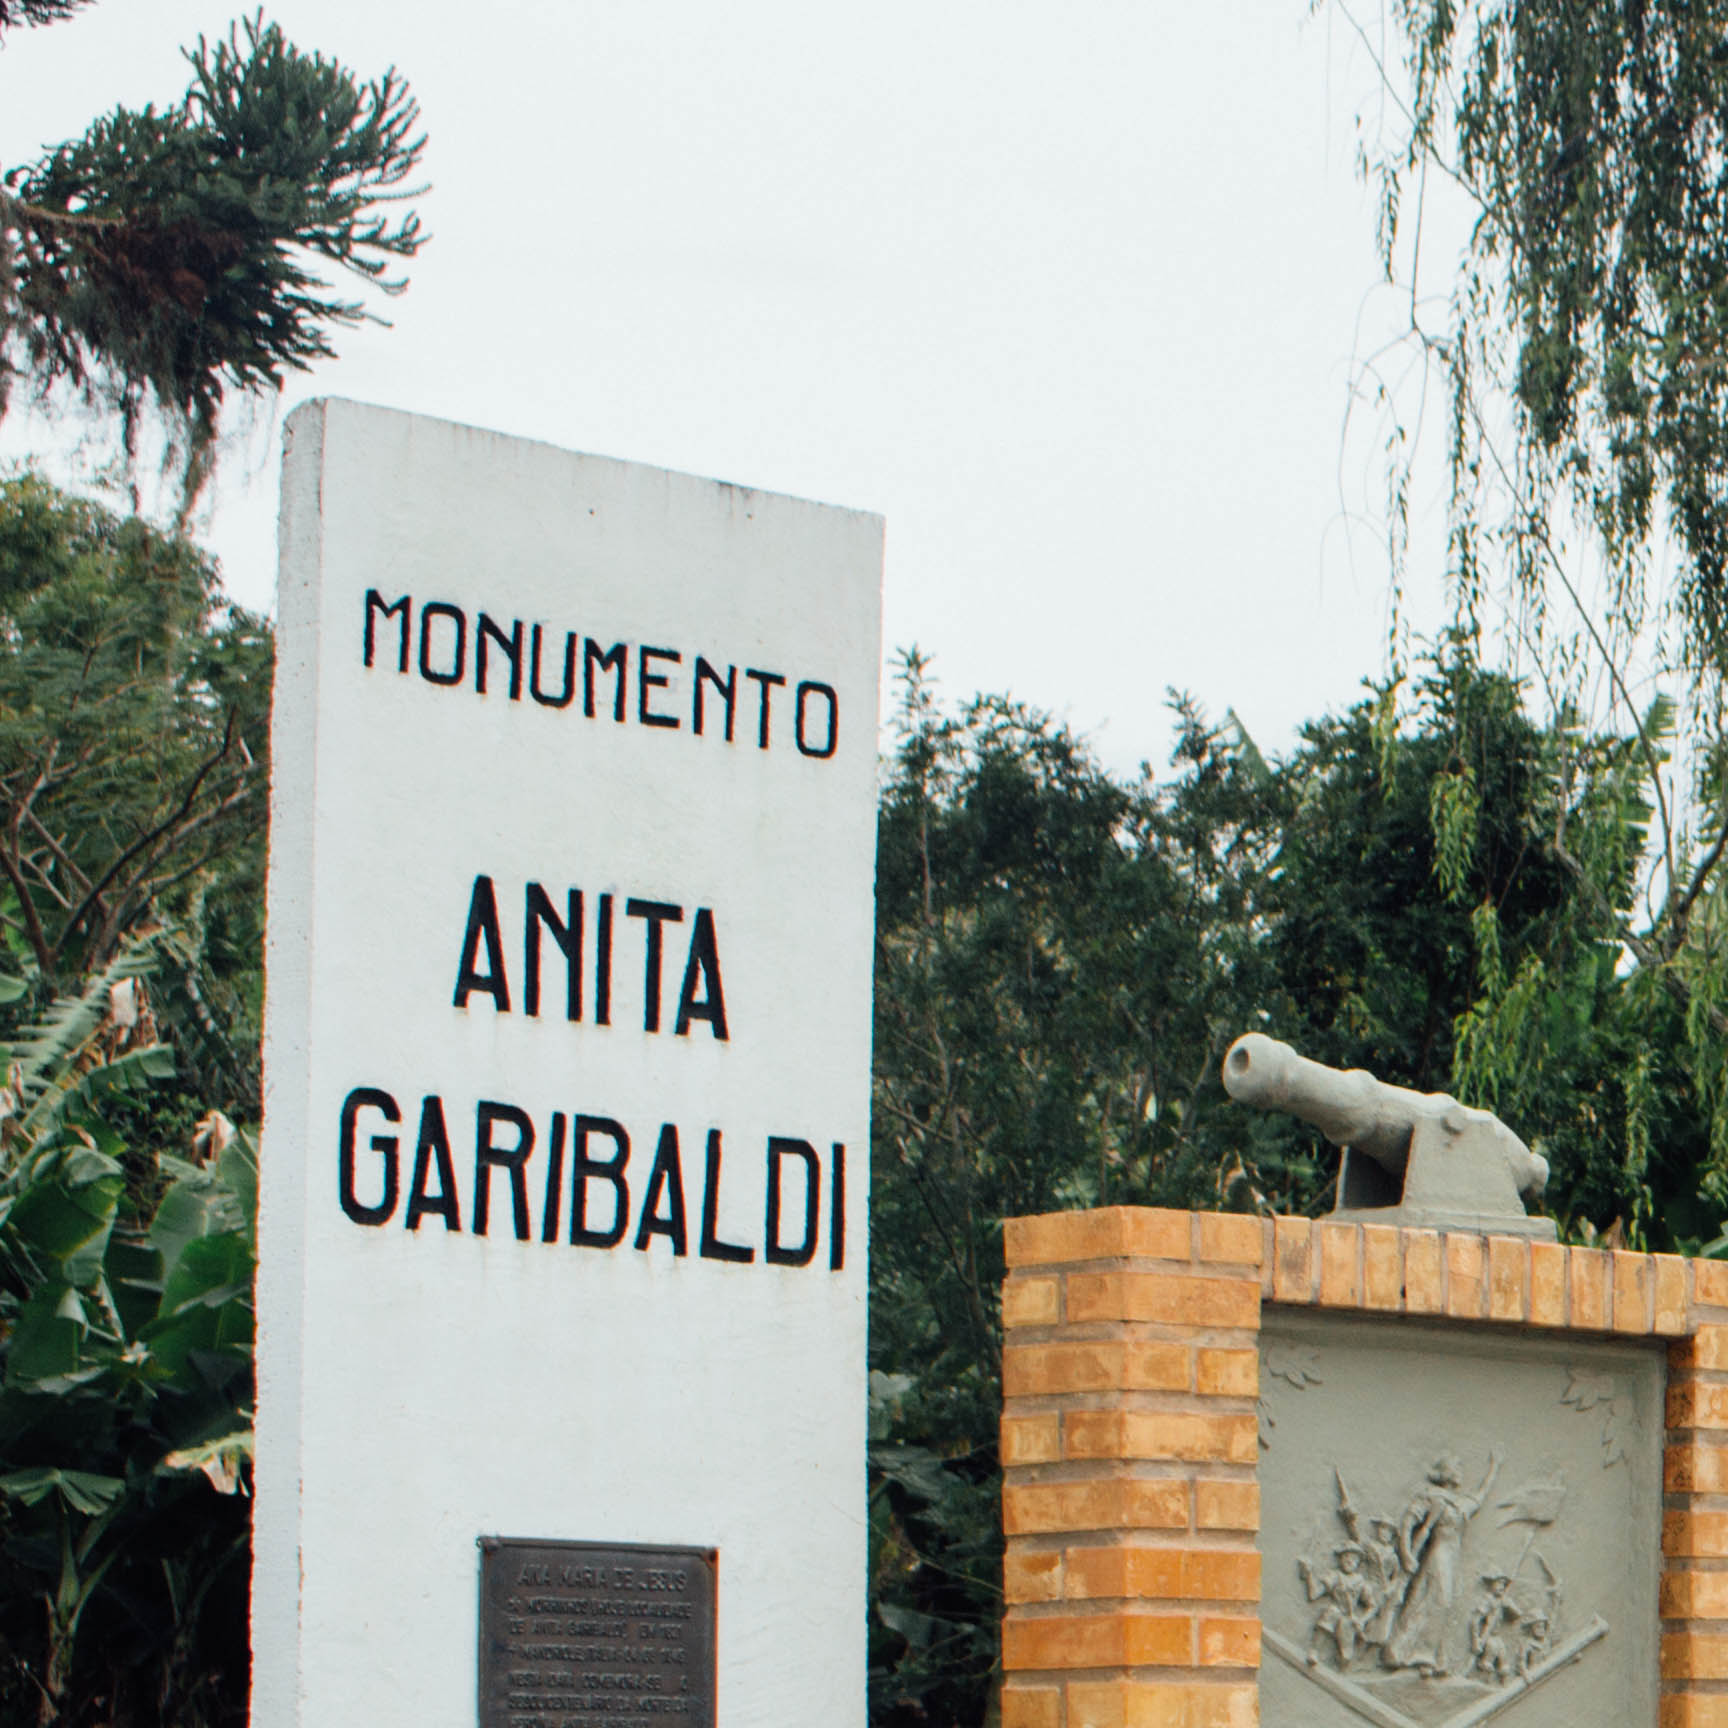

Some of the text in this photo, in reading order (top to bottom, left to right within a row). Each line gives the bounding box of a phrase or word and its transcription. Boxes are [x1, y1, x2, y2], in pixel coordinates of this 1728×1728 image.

[362, 588, 838, 759] MONUMENTO
[452, 873, 729, 1042] ANITA
[338, 1086, 846, 1272] GARIBALDI
